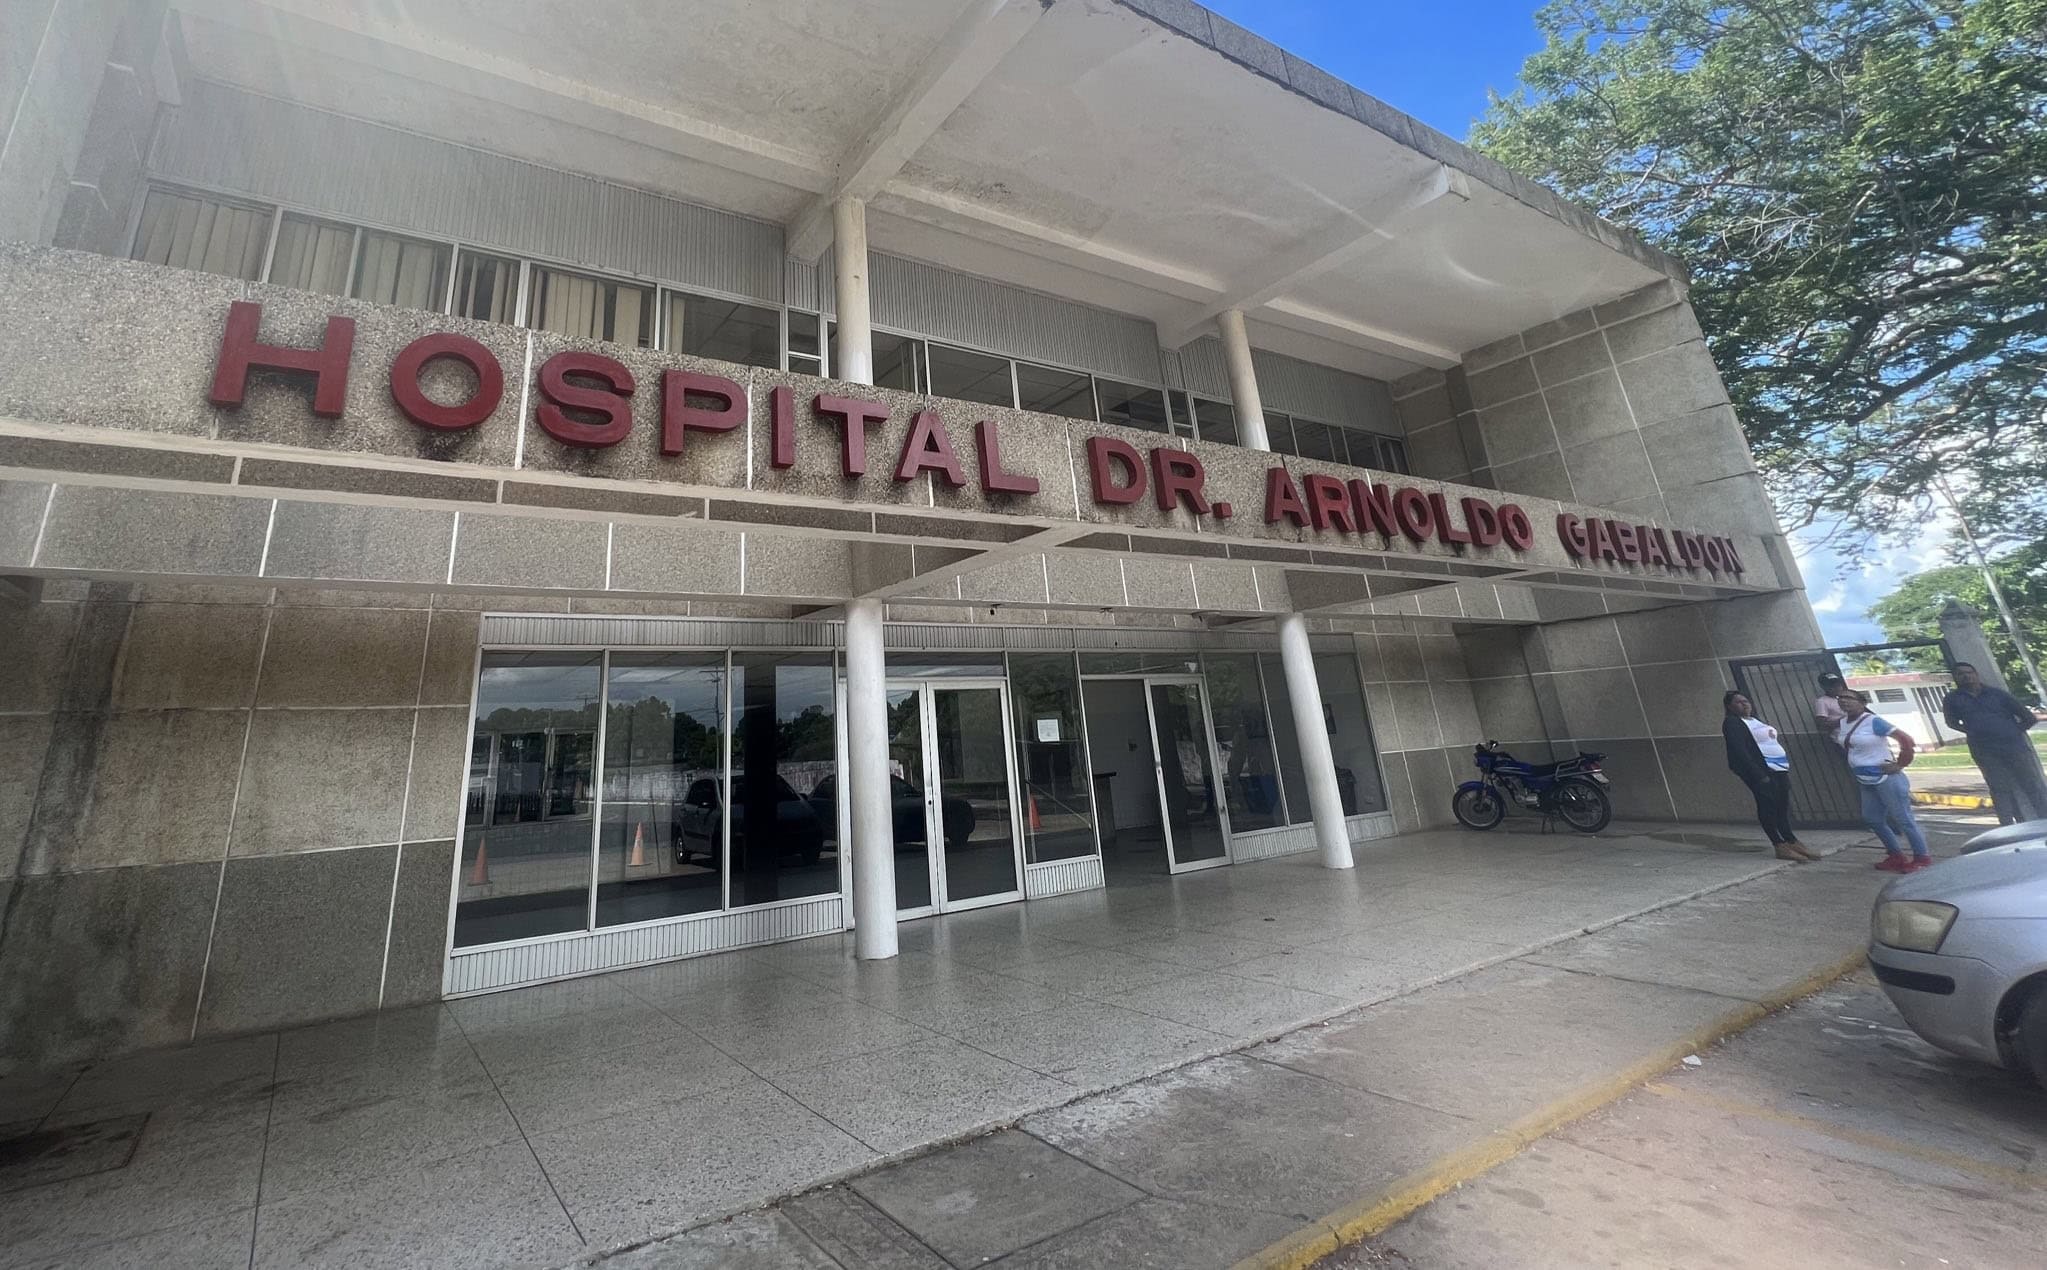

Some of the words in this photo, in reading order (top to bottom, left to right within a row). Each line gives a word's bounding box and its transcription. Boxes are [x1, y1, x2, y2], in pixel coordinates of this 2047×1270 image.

[209, 300, 1039, 495] HOSPITAL
[1087, 435, 1232, 519] DR.
[1265, 467, 1534, 551] ARNOLDO
[1557, 512, 1746, 574] GABALDON
